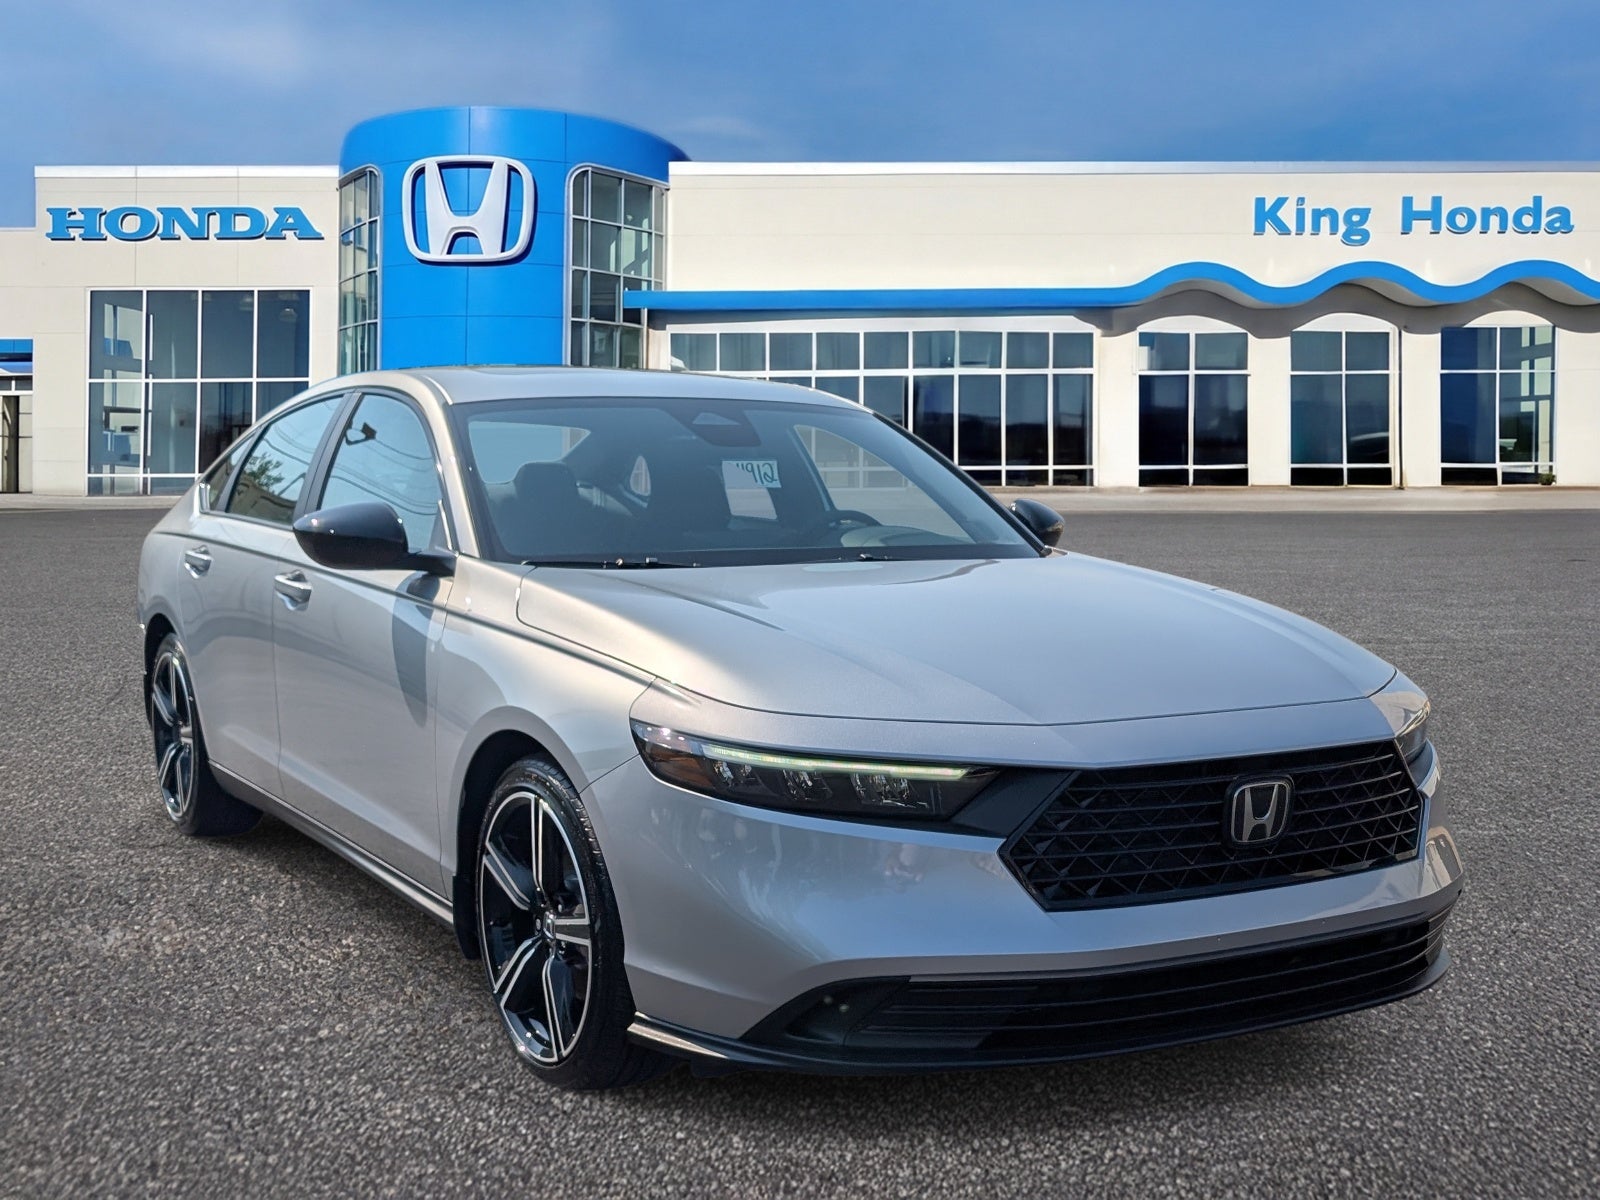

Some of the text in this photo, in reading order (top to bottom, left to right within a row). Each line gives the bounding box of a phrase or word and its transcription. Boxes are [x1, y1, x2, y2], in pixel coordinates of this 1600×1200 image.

[45, 206, 324, 241] HONDA
[1253, 195, 1575, 246] King Honda
